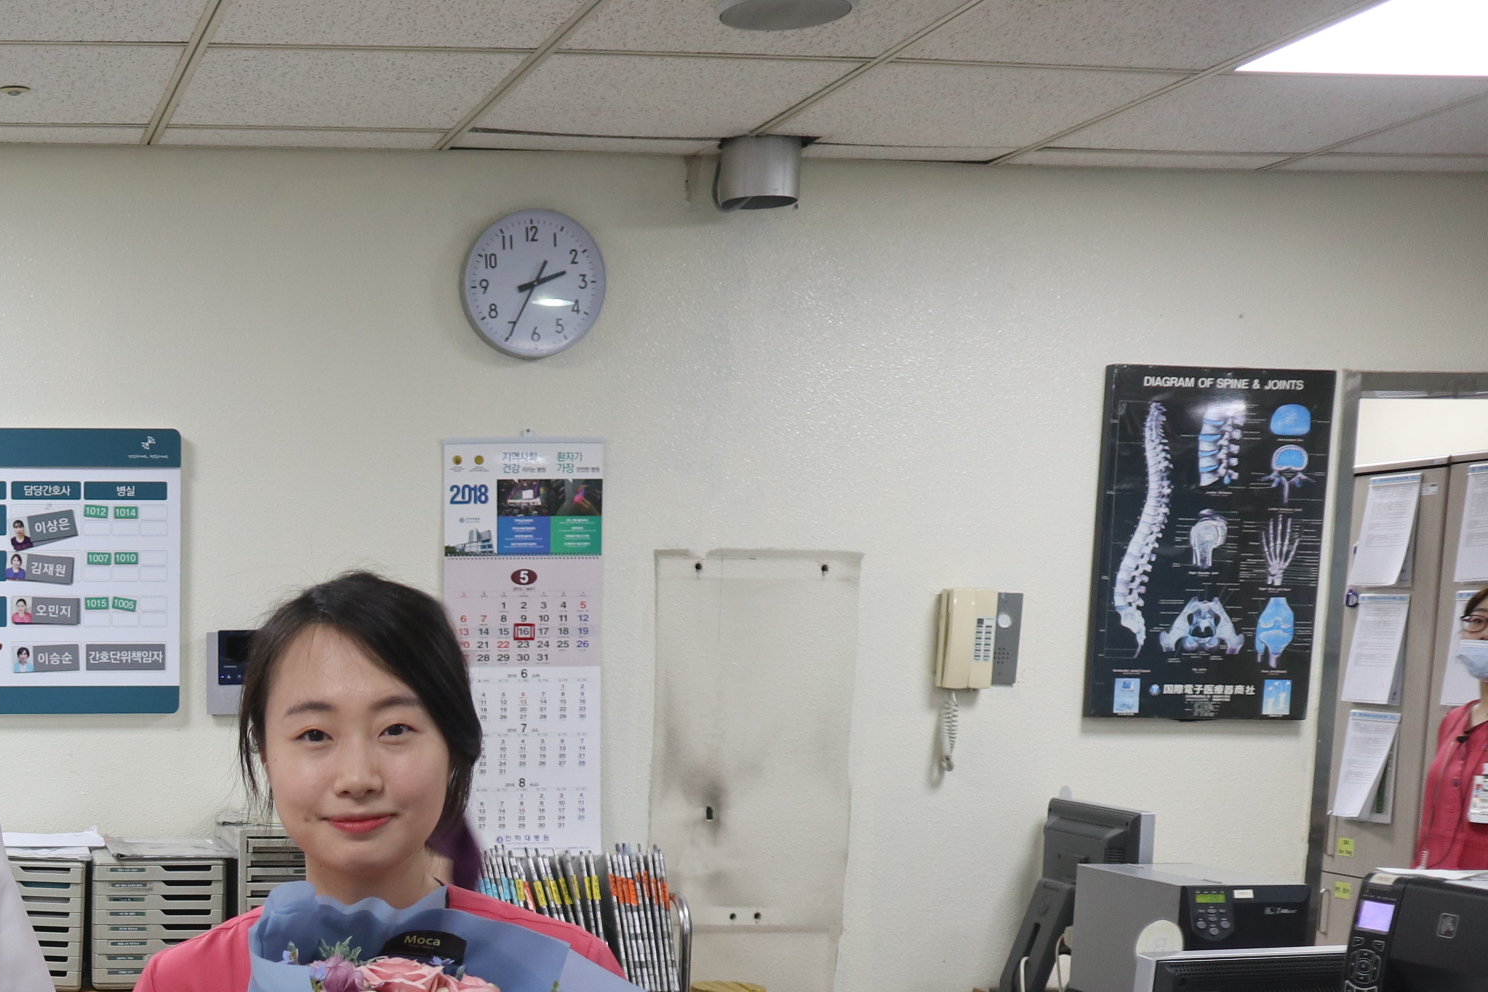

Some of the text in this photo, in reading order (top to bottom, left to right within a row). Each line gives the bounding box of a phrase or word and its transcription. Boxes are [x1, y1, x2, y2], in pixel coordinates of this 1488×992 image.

[525, 225, 539, 242] 12
[553, 232, 557, 248] 1
[502, 234, 513, 250] 11
[484, 253, 498, 269] 10
[569, 248, 579, 265] 2
[479, 278, 490, 294] 9
[578, 273, 588, 289] 3
[488, 303, 499, 319] 8
[571, 299, 581, 315] 4
[555, 318, 565, 333] 5
[531, 326, 541, 341] 6
[1143, 375, 1305, 391] DIAGRAM OF SPINE & JOINTS
[556, 451, 584, 462] 환자가
[502, 463, 520, 474] 건강
[556, 463, 574, 474] 가장
[23, 485, 71, 497] 담당간호사
[116, 485, 136, 497] 병실
[449, 483, 490, 505] 2018
[85, 507, 107, 517] 1012
[115, 508, 137, 517] 1014
[34, 517, 71, 534] 이상은
[88, 553, 110, 563] 1007
[115, 553, 137, 562] 1010
[30, 561, 67, 577] 김재원
[519, 570, 529, 584] 5
[86, 599, 107, 608] 1015
[114, 599, 135, 609] 1005
[520, 601, 527, 609] 2
[540, 601, 547, 609] 3
[560, 601, 567, 609] 4
[580, 601, 587, 609] 5
[35, 604, 72, 618] 오민지
[478, 628, 489, 636] 14
[518, 627, 530, 635] 16
[538, 627, 549, 635] 17
[558, 627, 569, 635] 18
[578, 627, 589, 635] 19
[37, 651, 73, 665] 이승순
[88, 651, 163, 664] 간호단위책임자
[520, 668, 528, 679] 6
[520, 723, 528, 733] 7
[518, 777, 526, 788] 8
[403, 935, 441, 946] Moca
